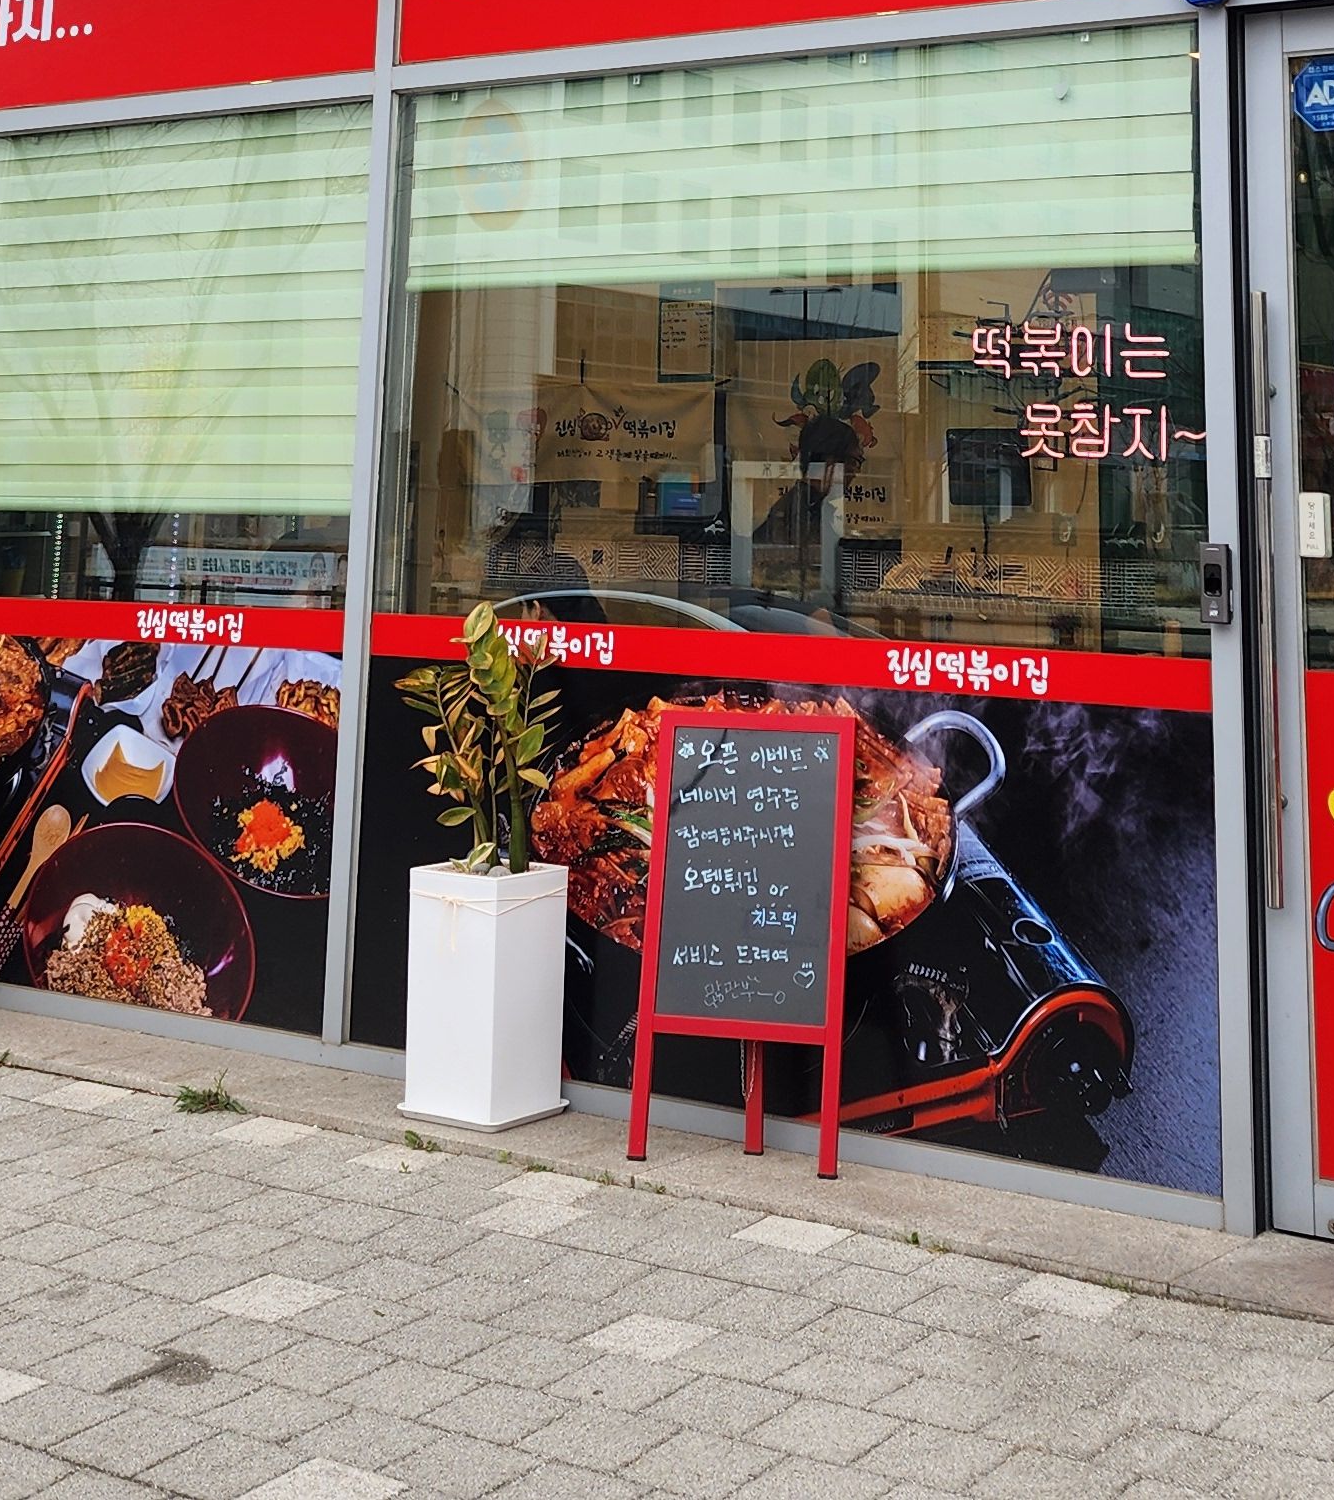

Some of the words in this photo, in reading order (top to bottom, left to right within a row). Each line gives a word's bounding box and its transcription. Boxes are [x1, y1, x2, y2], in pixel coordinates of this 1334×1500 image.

[971, 320, 1170, 380] 떡볶이는
[1019, 403, 1207, 462] 못참지~
[136, 610, 244, 643] 진심떡볶이집
[888, 648, 1050, 695] 진심떡볶이집
[698, 740, 739, 775] 오픈
[750, 746, 808, 774] 이벤트
[679, 786, 737, 804] 네이버
[746, 786, 800, 812] 영수증
[769, 883, 789, 897] or
[672, 944, 723, 966] 서비스
